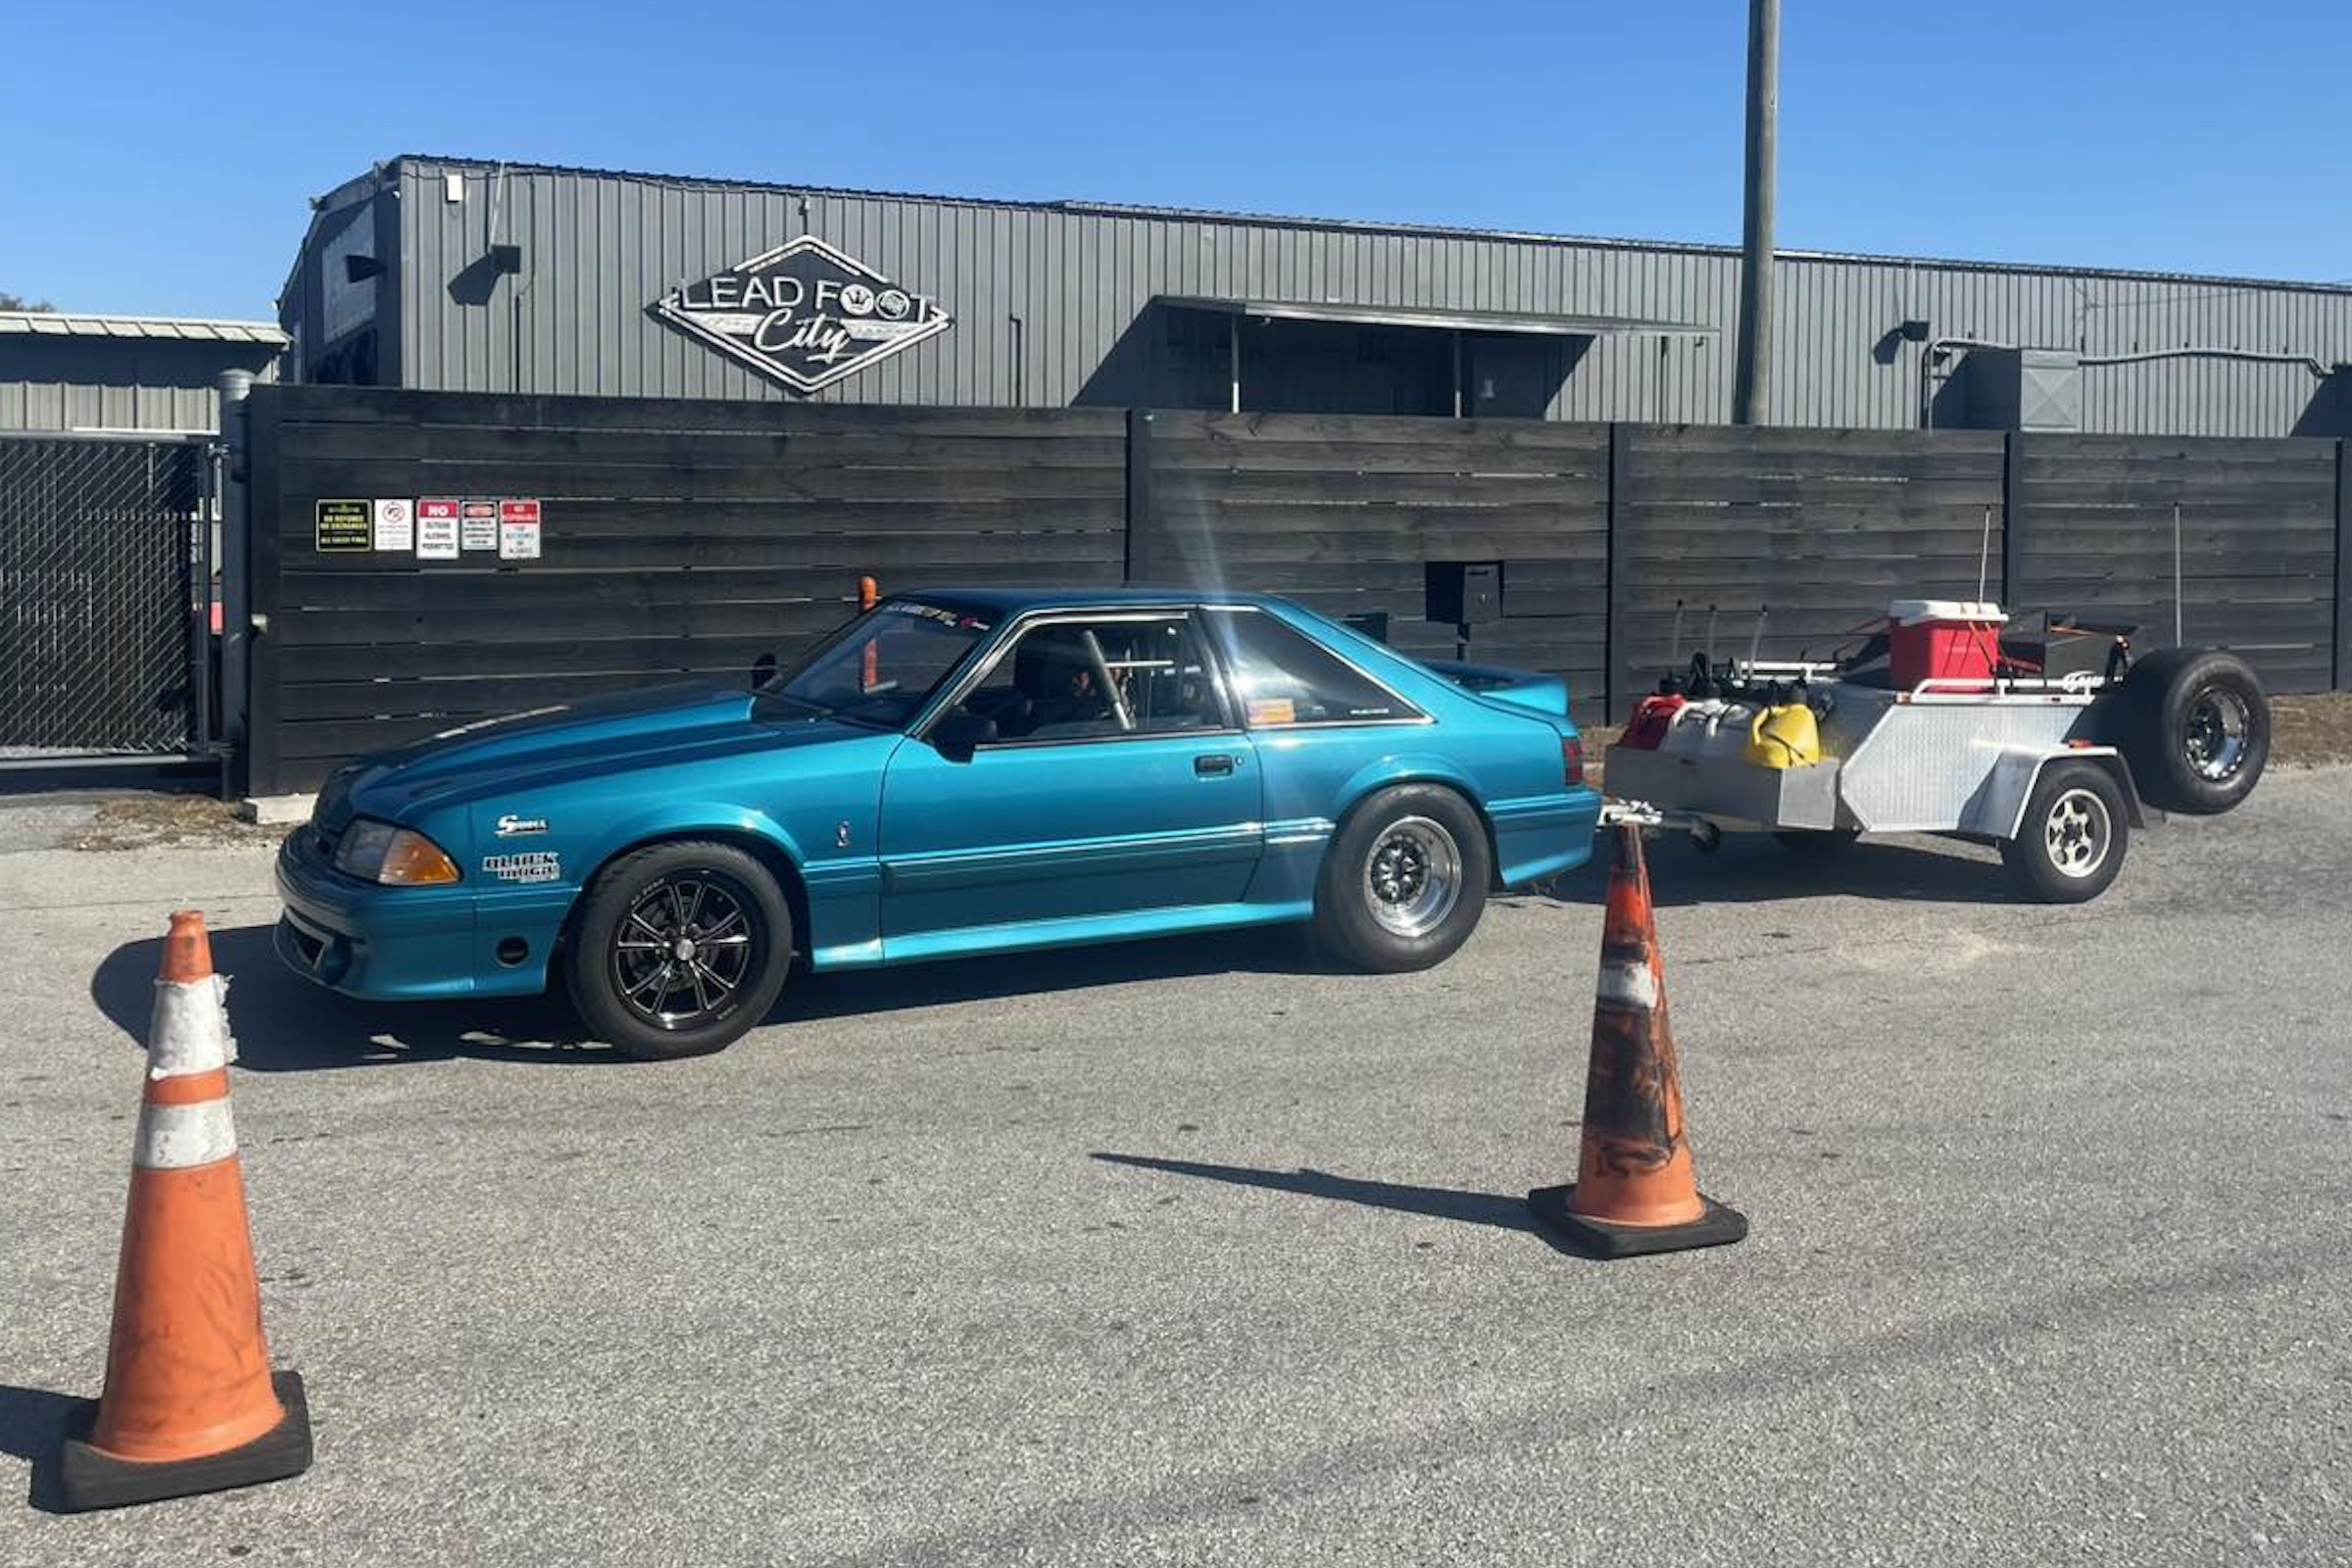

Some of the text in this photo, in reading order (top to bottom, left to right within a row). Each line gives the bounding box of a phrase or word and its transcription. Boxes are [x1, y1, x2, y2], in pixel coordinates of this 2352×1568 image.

[681, 276, 804, 310] LEAD
[754, 308, 859, 365] City
[427, 504, 449, 516] NO
